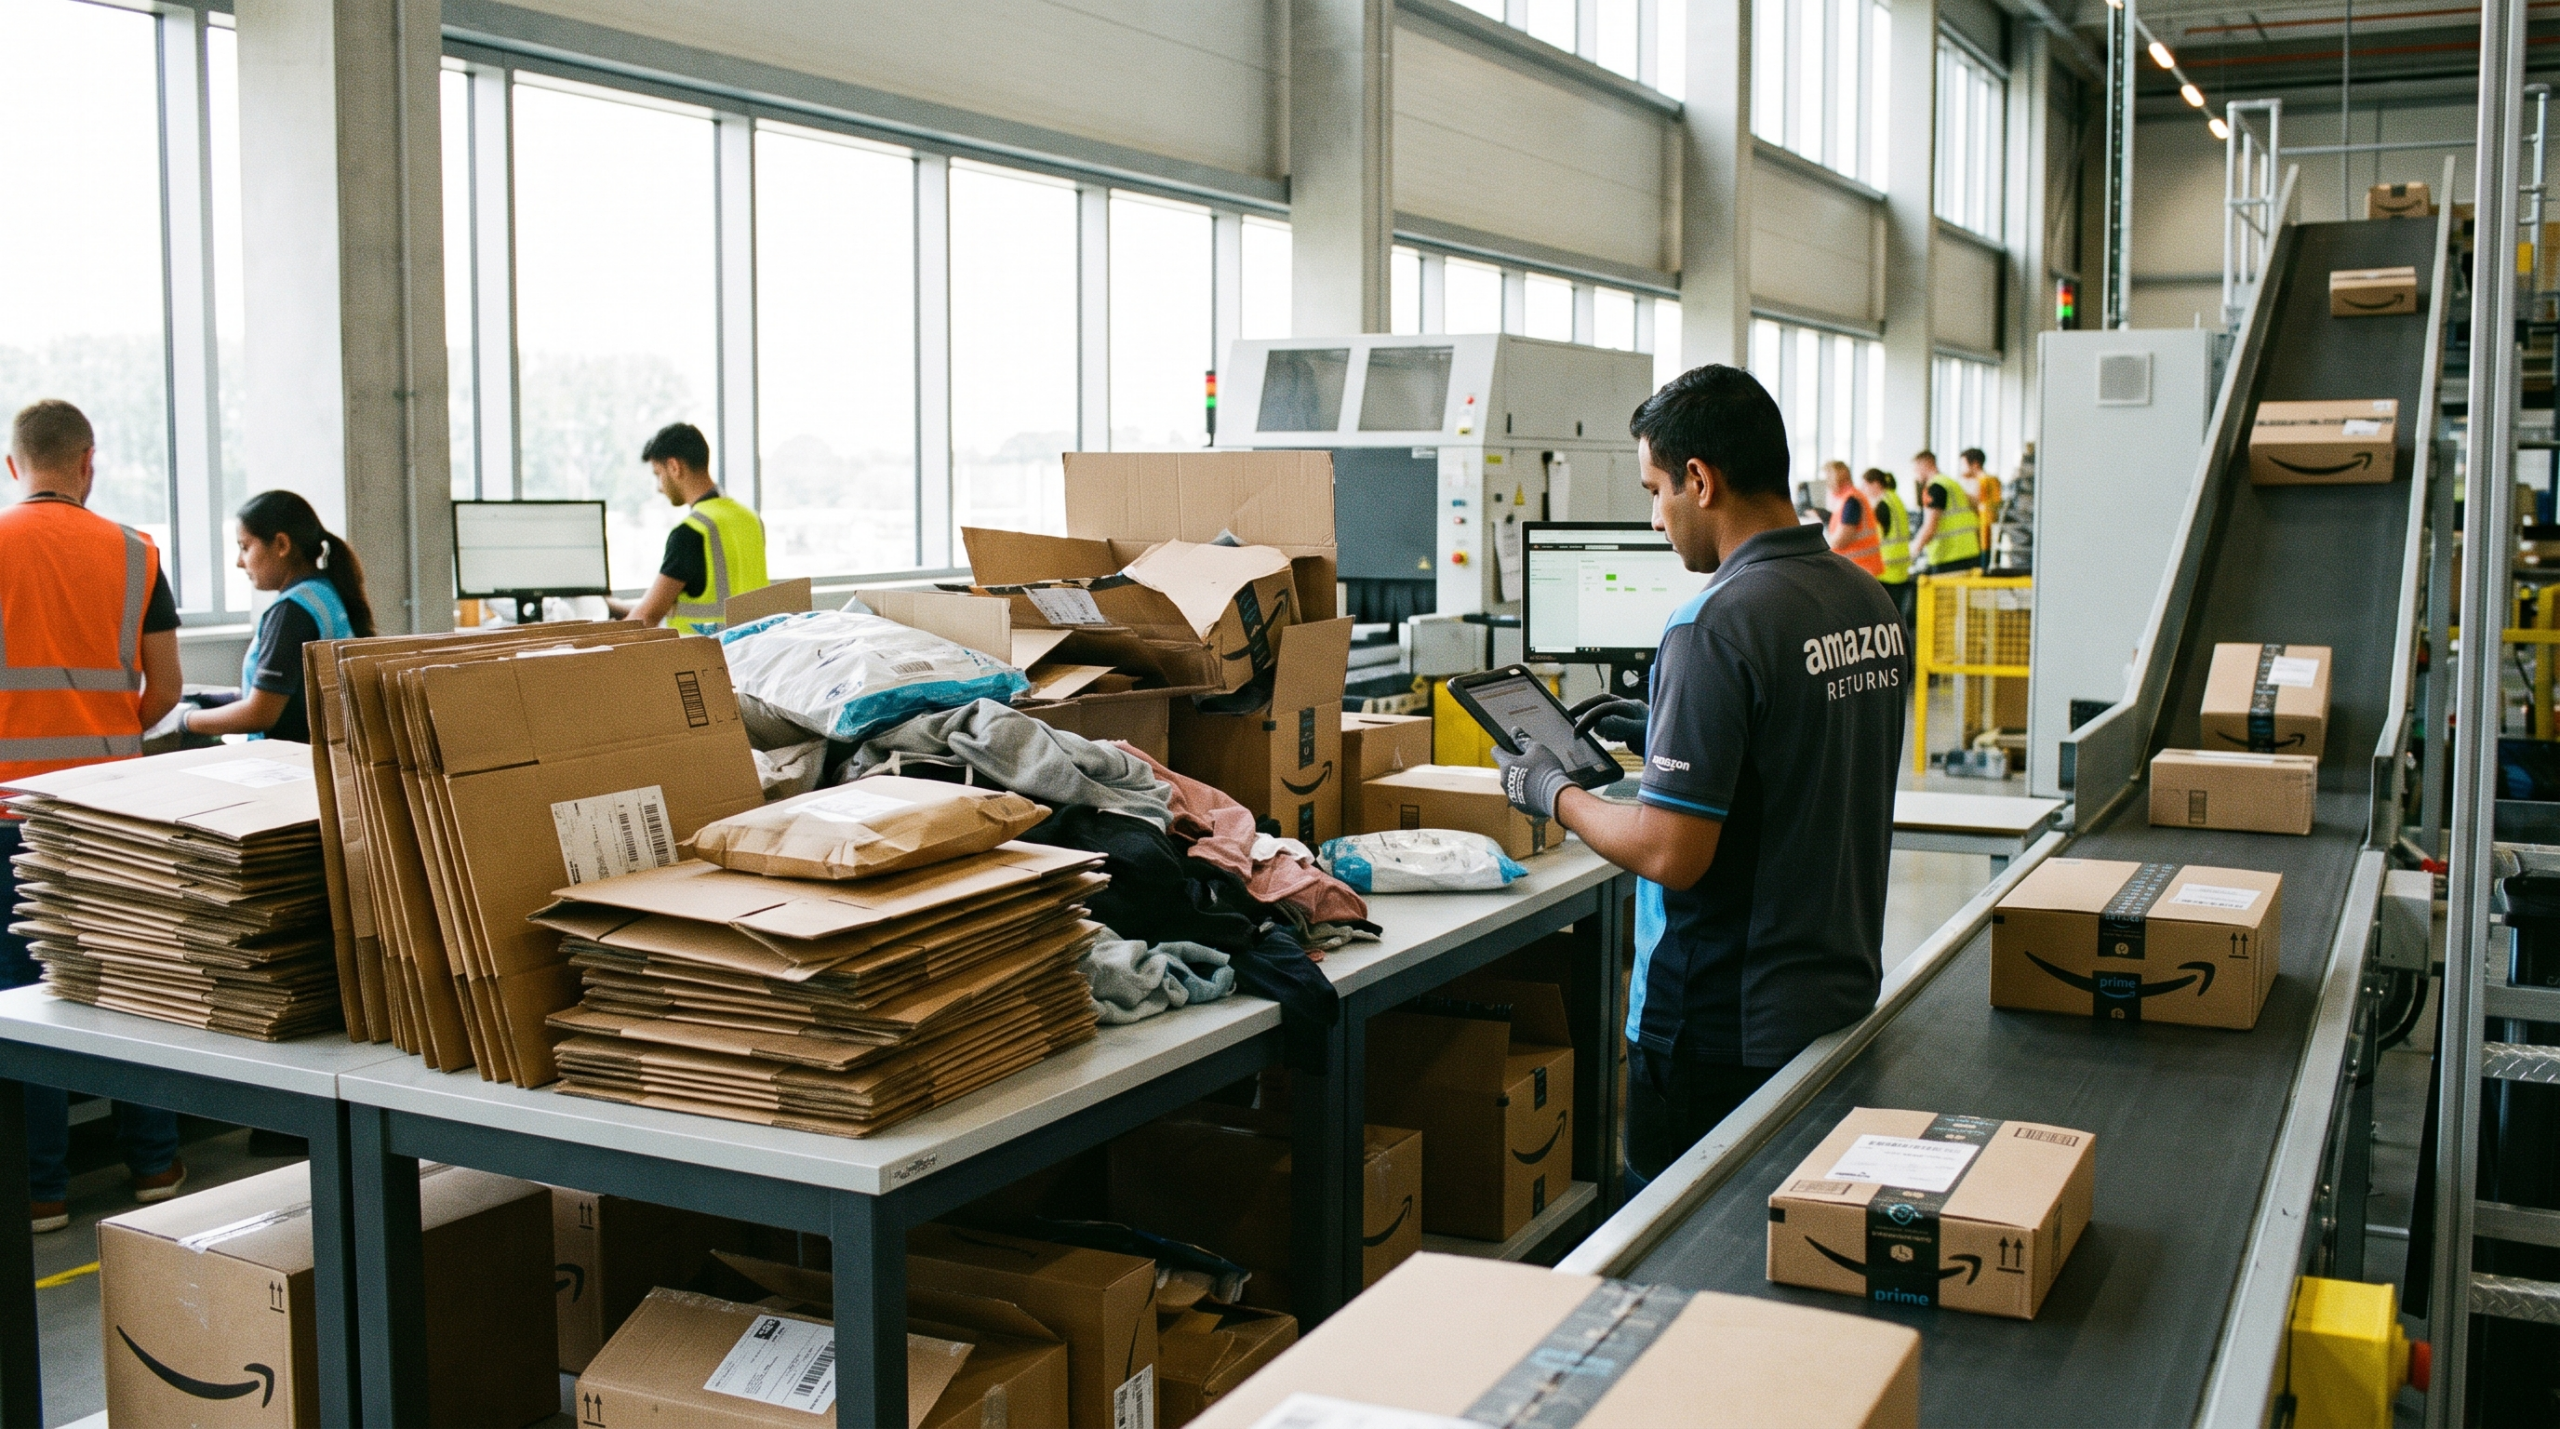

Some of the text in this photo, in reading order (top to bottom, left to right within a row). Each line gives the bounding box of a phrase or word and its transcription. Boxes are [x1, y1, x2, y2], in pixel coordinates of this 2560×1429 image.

[1803, 623, 1904, 675] amazon
[1827, 668, 1899, 701] RETURNS
[2100, 977, 2136, 988] prime
[1875, 1287, 1929, 1306] prime
